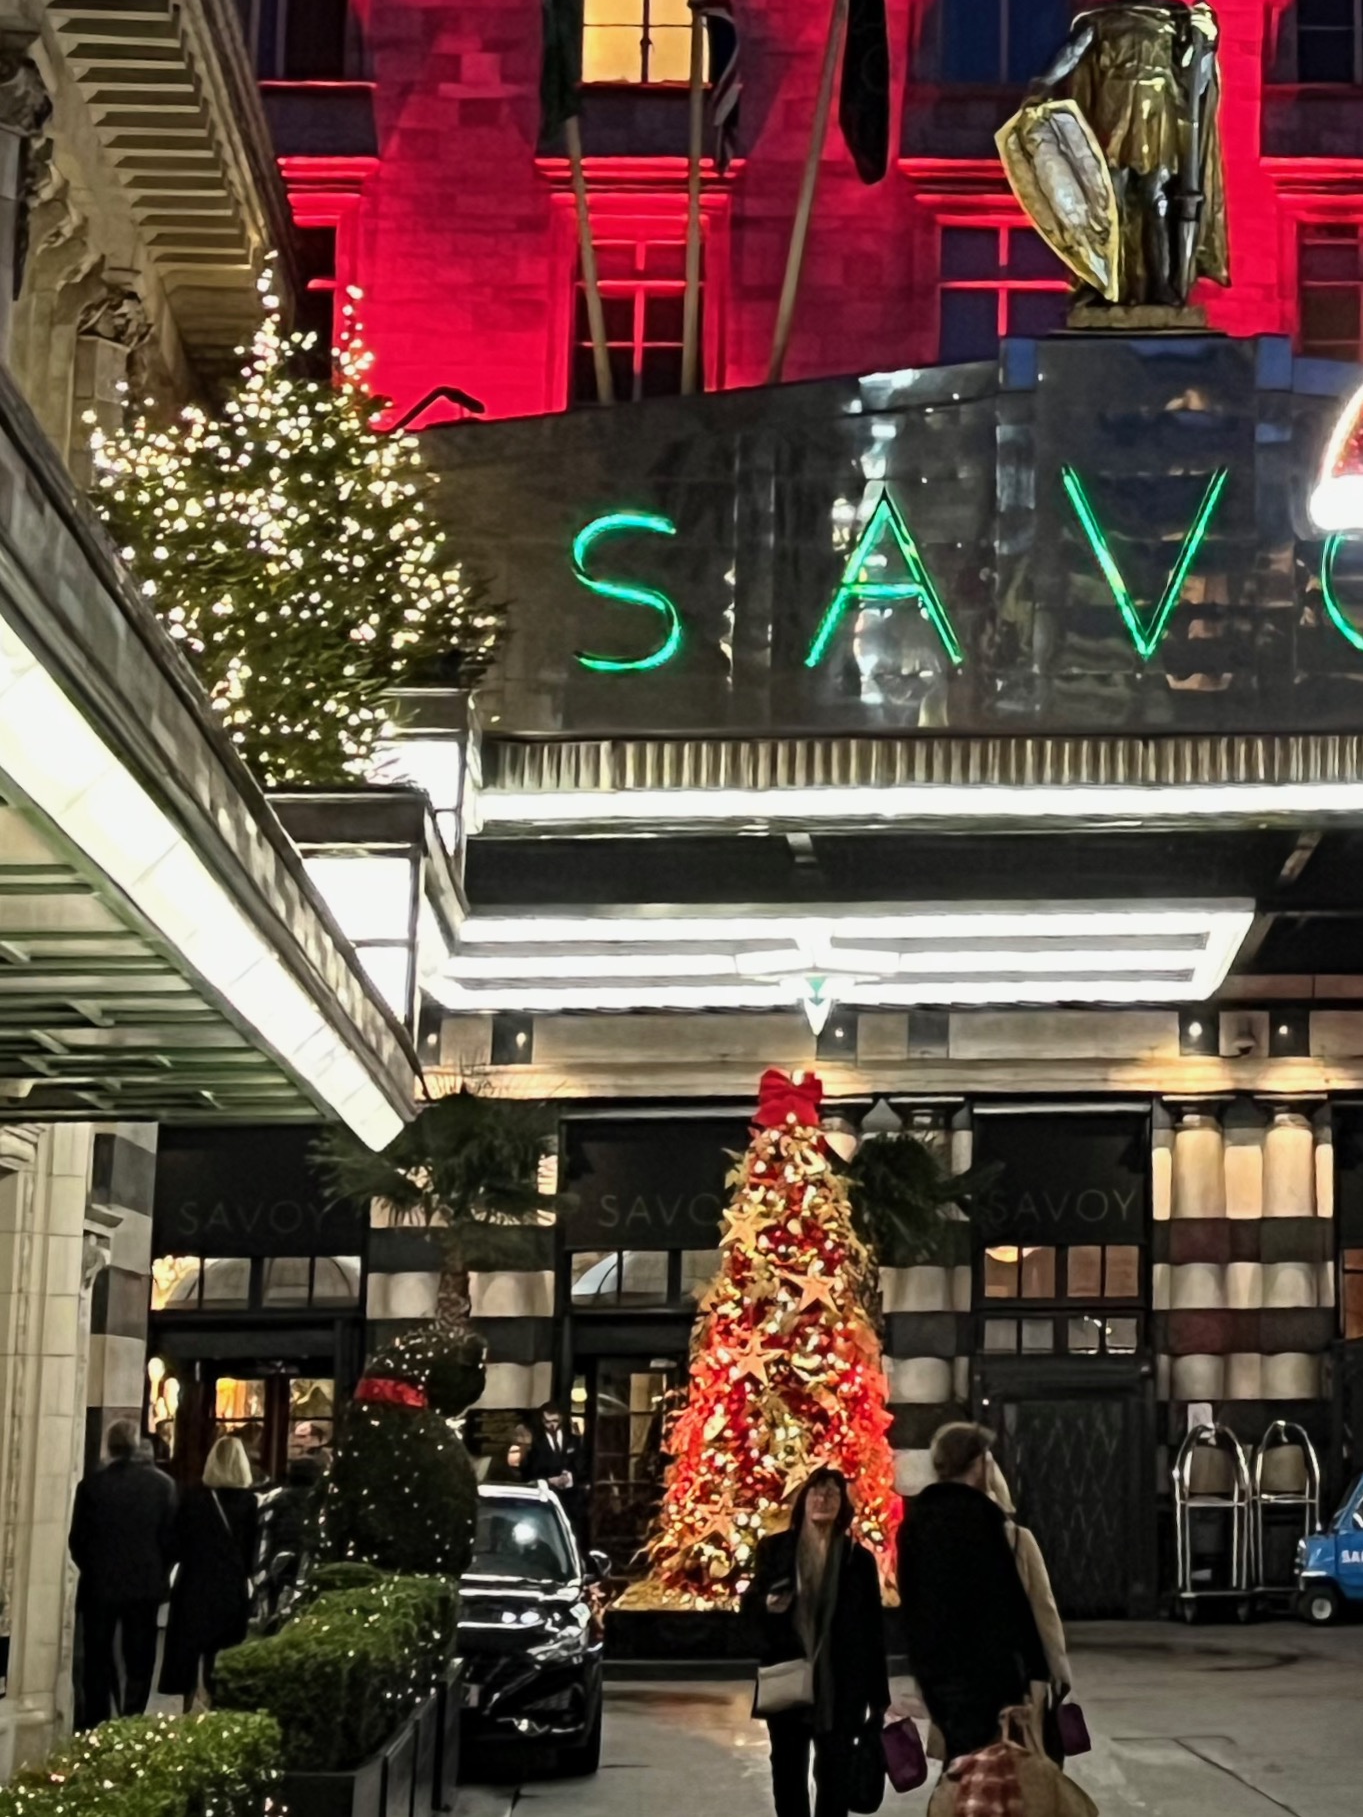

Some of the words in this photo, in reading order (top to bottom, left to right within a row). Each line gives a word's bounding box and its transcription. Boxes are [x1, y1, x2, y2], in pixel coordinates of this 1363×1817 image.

[179, 1201, 331, 1235] SAVOY
[598, 1191, 722, 1228] SAVO
[986, 1189, 1137, 1225] SAVOY
